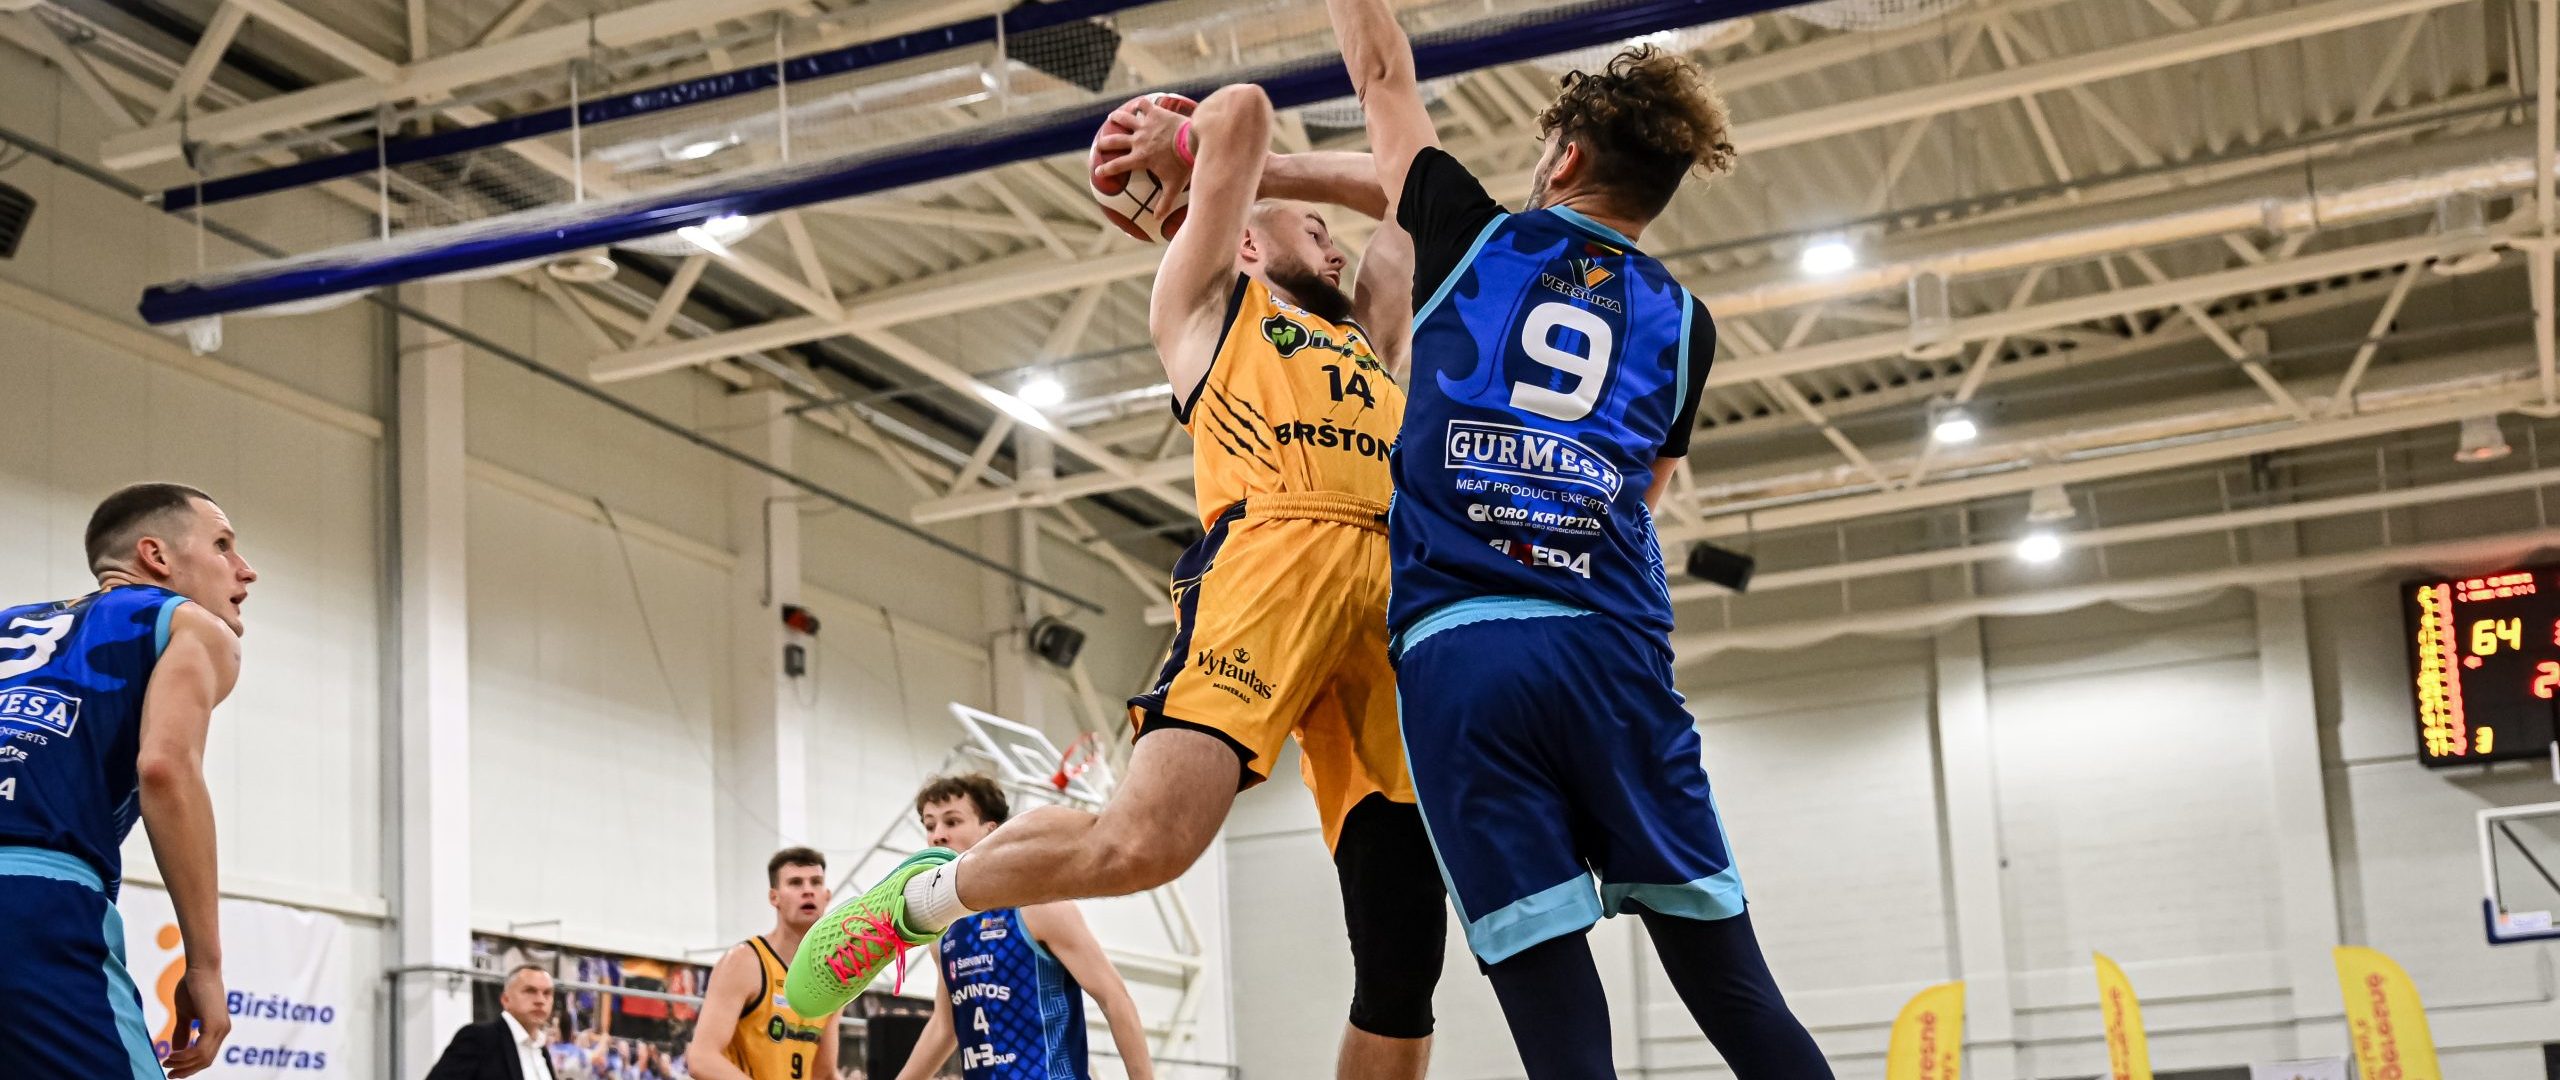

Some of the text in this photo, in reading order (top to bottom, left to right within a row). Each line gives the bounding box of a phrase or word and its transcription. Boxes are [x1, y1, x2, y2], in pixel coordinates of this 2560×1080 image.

[1542, 273, 1621, 313] VERSLIKA
[1509, 302, 1613, 422] 9
[1322, 365, 1375, 409] 14
[1456, 479, 1609, 515] MEAT PRODUCT EXPERTS
[1494, 507, 1528, 520] ORO
[1532, 512, 1602, 530] KRYPTIS
[0, 614, 74, 680] 3
[2472, 617, 2521, 656] 64
[1198, 649, 1272, 700] Vytautas
[1213, 683, 1250, 704] MINERALS
[227, 990, 335, 1024] Birštono
[974, 1007, 990, 1035] 4
[225, 1044, 327, 1070] centras
[791, 1052, 803, 1079] 9
